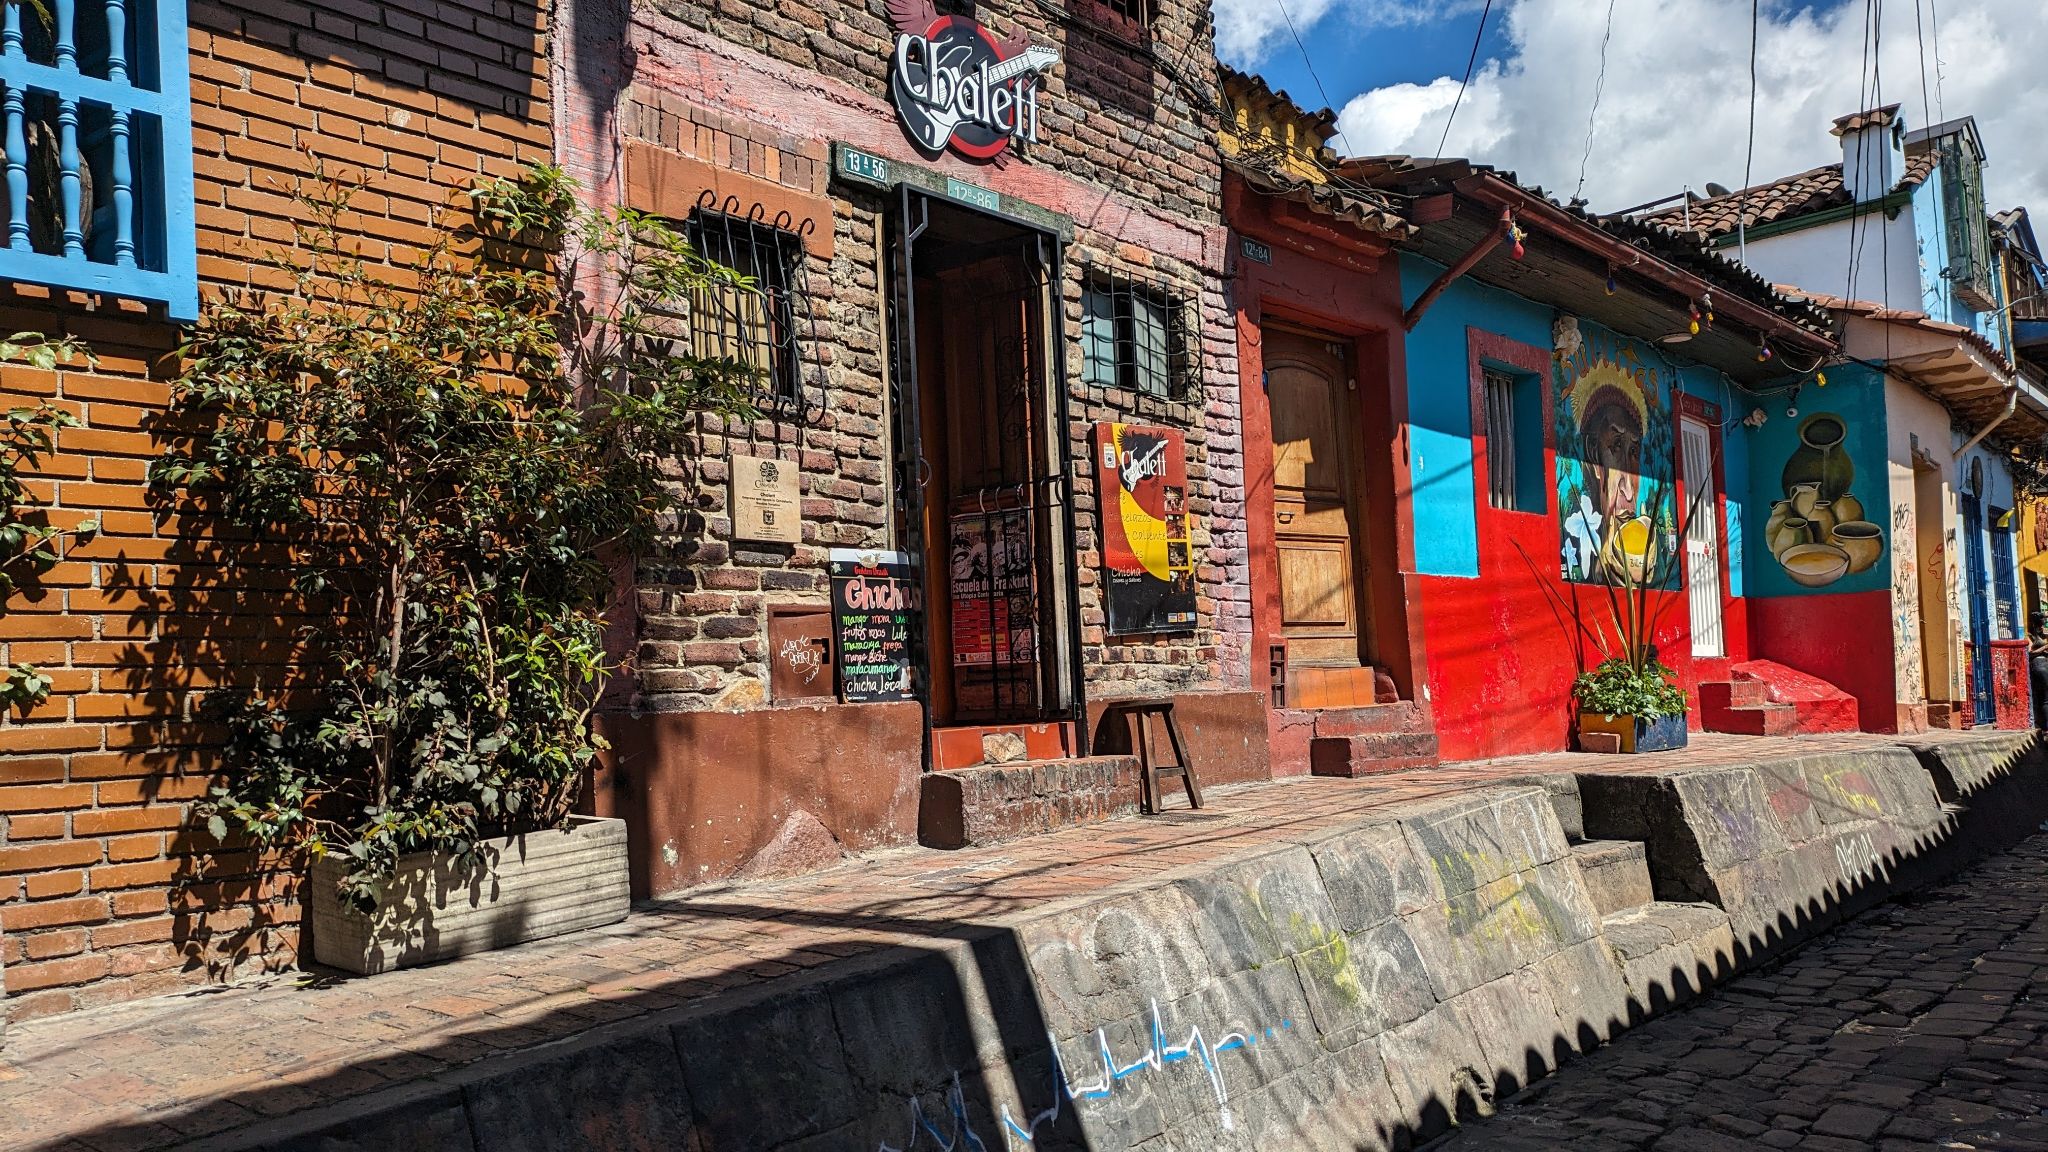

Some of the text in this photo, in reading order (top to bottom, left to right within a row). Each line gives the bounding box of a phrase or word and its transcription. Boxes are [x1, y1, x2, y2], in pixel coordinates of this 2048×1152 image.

[896, 33, 1041, 144] Chalett
[848, 152, 860, 172] 13
[872, 160, 885, 179] 56
[1121, 446, 1167, 477] Chalett
